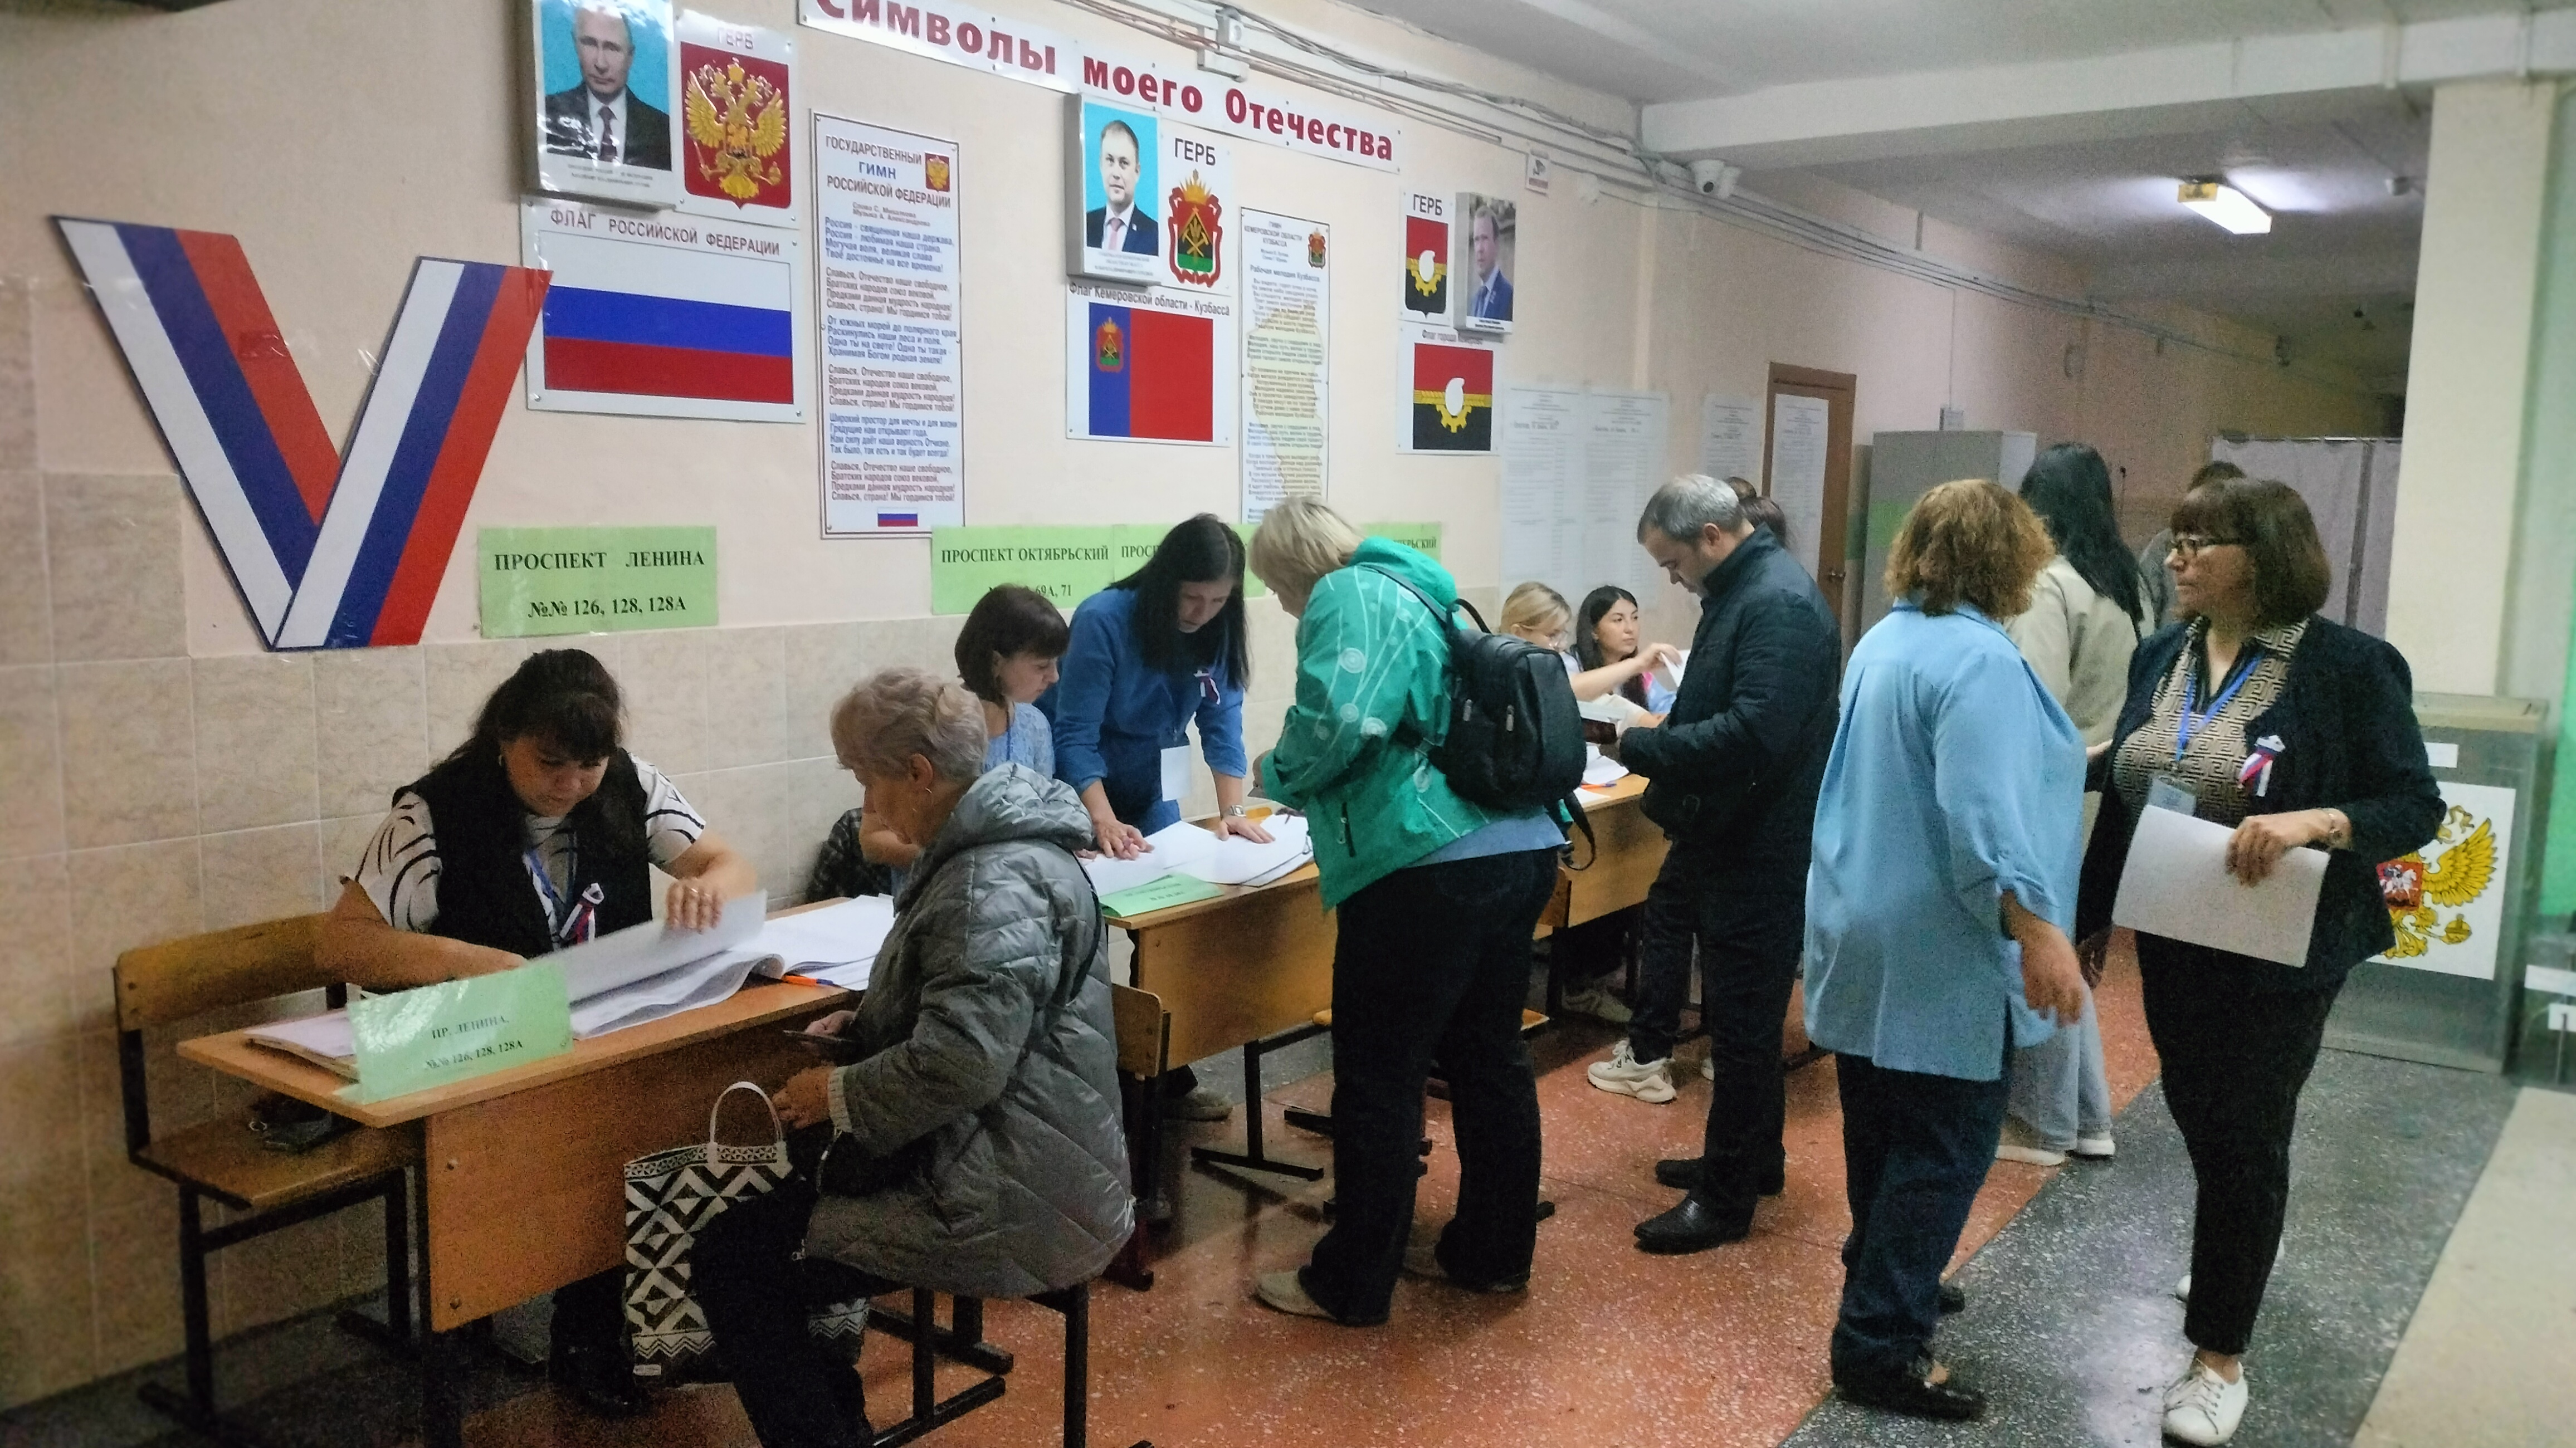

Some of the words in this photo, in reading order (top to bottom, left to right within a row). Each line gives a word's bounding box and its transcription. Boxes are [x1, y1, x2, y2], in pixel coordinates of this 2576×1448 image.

[718, 27, 754, 50] ГЕРБ
[1084, 56, 1203, 113] моего
[1226, 88, 1392, 161] Отечества
[826, 135, 922, 165] ГОСУДАРСТВЕННЫЙ
[1175, 138, 1216, 166] ГЕРБ
[858, 161, 896, 179] ГИМН
[827, 174, 893, 198] РОССИЙСКОЙ
[895, 187, 951, 208] ФЕДЕРАЦИИ
[1413, 193, 1443, 217] ГЕРБ
[550, 209, 596, 229] ФЛАГ
[609, 218, 698, 244] РОССИЙСКОЙ
[706, 232, 780, 256] ФЕДЕРАЦИИ
[1069, 281, 1092, 296] Флаг
[1095, 285, 1153, 305] Кемеровской
[1155, 295, 1188, 310] области
[1195, 300, 1230, 316] Кузбасса
[495, 552, 607, 571] ПРОСПЕКТ
[625, 550, 705, 568] ЛЕНИНА
[941, 547, 1014, 563] ПРОСПЕКТ
[1018, 545, 1109, 561] ОКТЯБРЬСКИЙ
[1061, 584, 1071, 596] 71
[528, 600, 568, 618] №№
[573, 599, 605, 616] 126,
[612, 598, 643, 614] 128,
[649, 596, 687, 612] 128А
[499, 1039, 523, 1053] 128А
